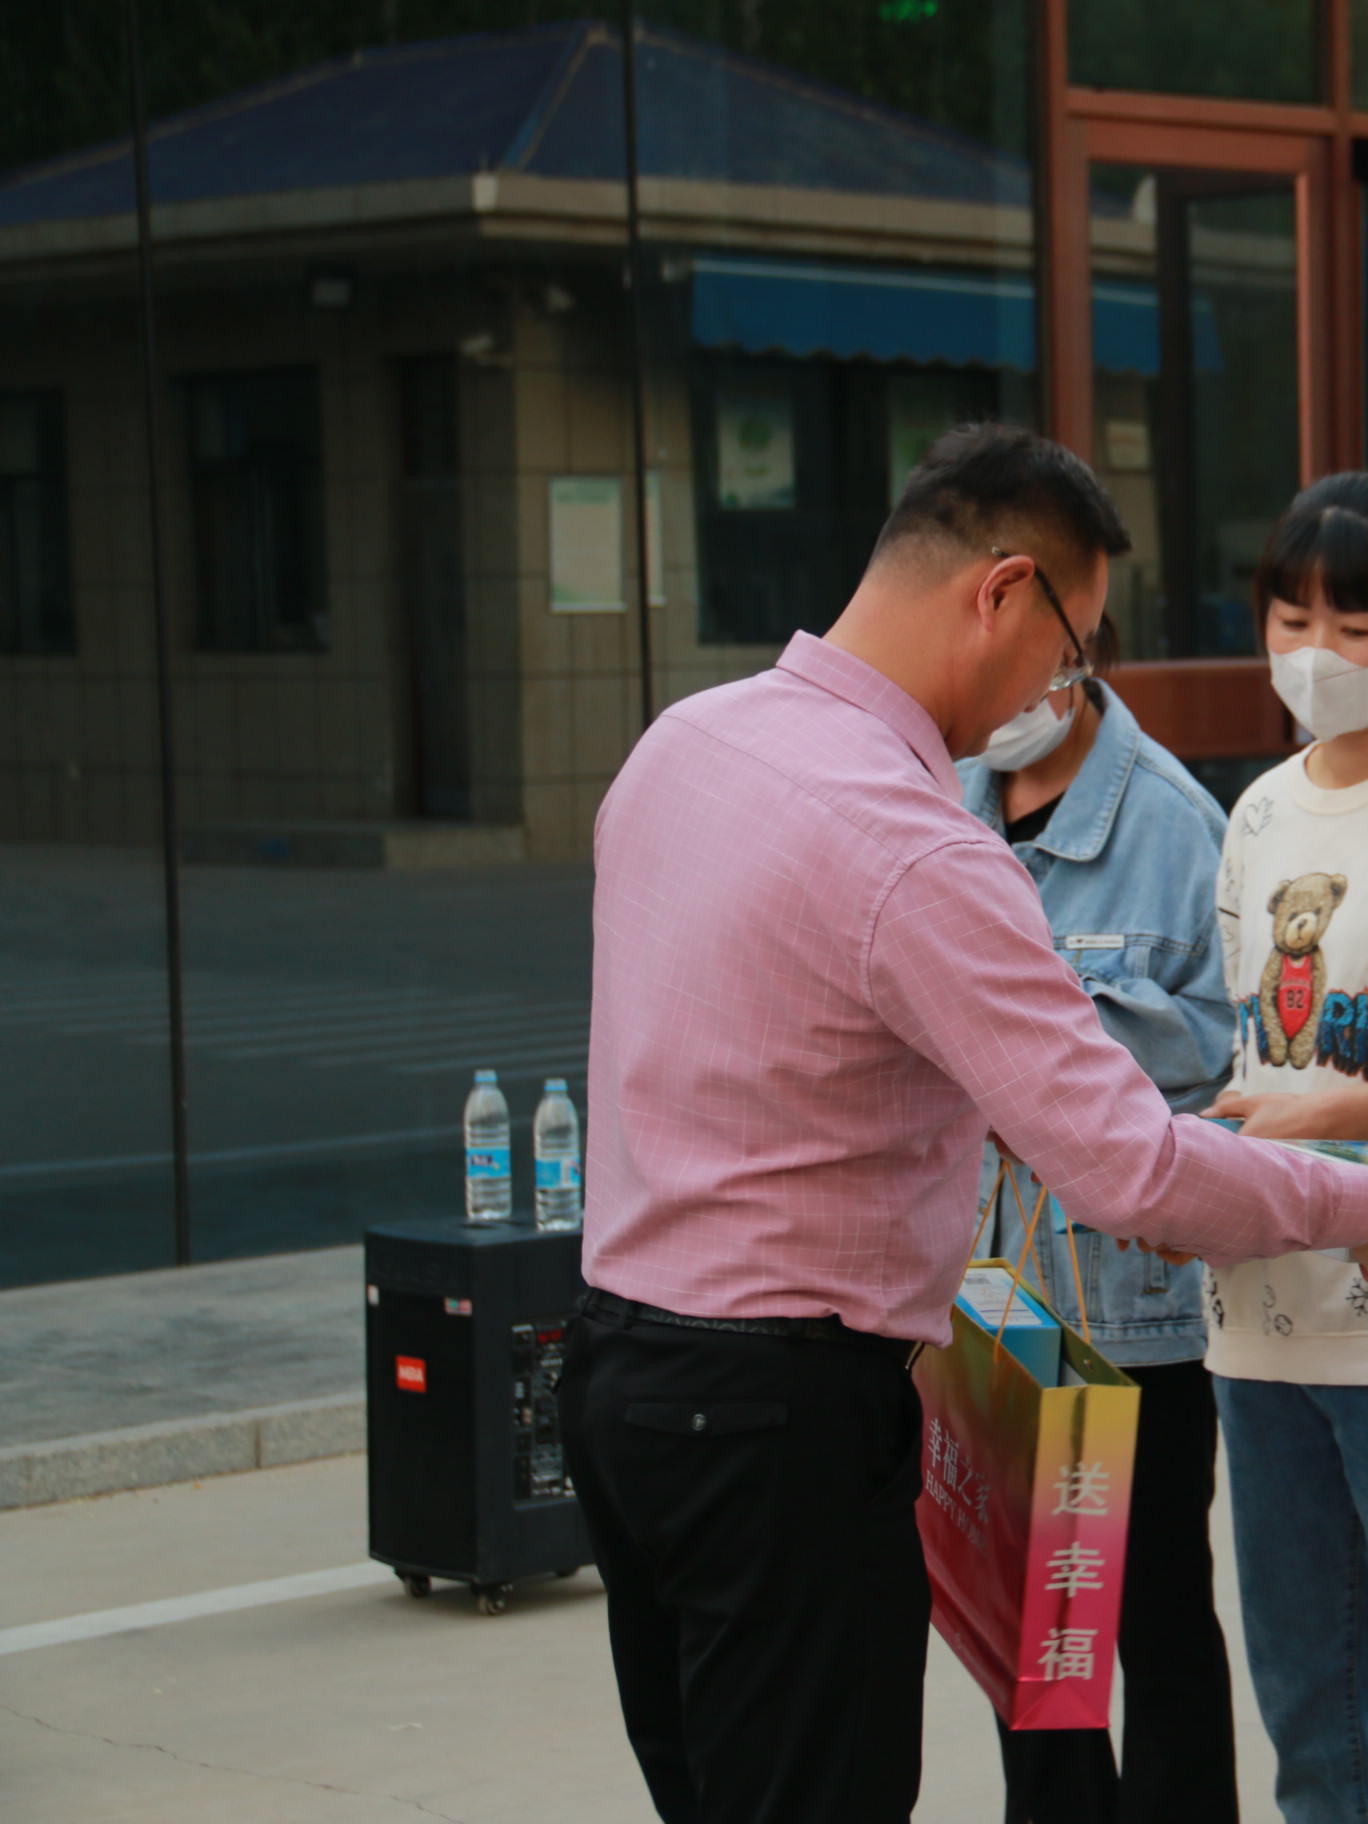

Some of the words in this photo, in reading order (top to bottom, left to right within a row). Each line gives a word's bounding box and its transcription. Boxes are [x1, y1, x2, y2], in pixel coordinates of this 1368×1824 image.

[925, 1469, 957, 1520] HAPPY
[927, 1417, 993, 1525] 幸福之家
[1037, 1461, 1111, 1682] 送幸福
